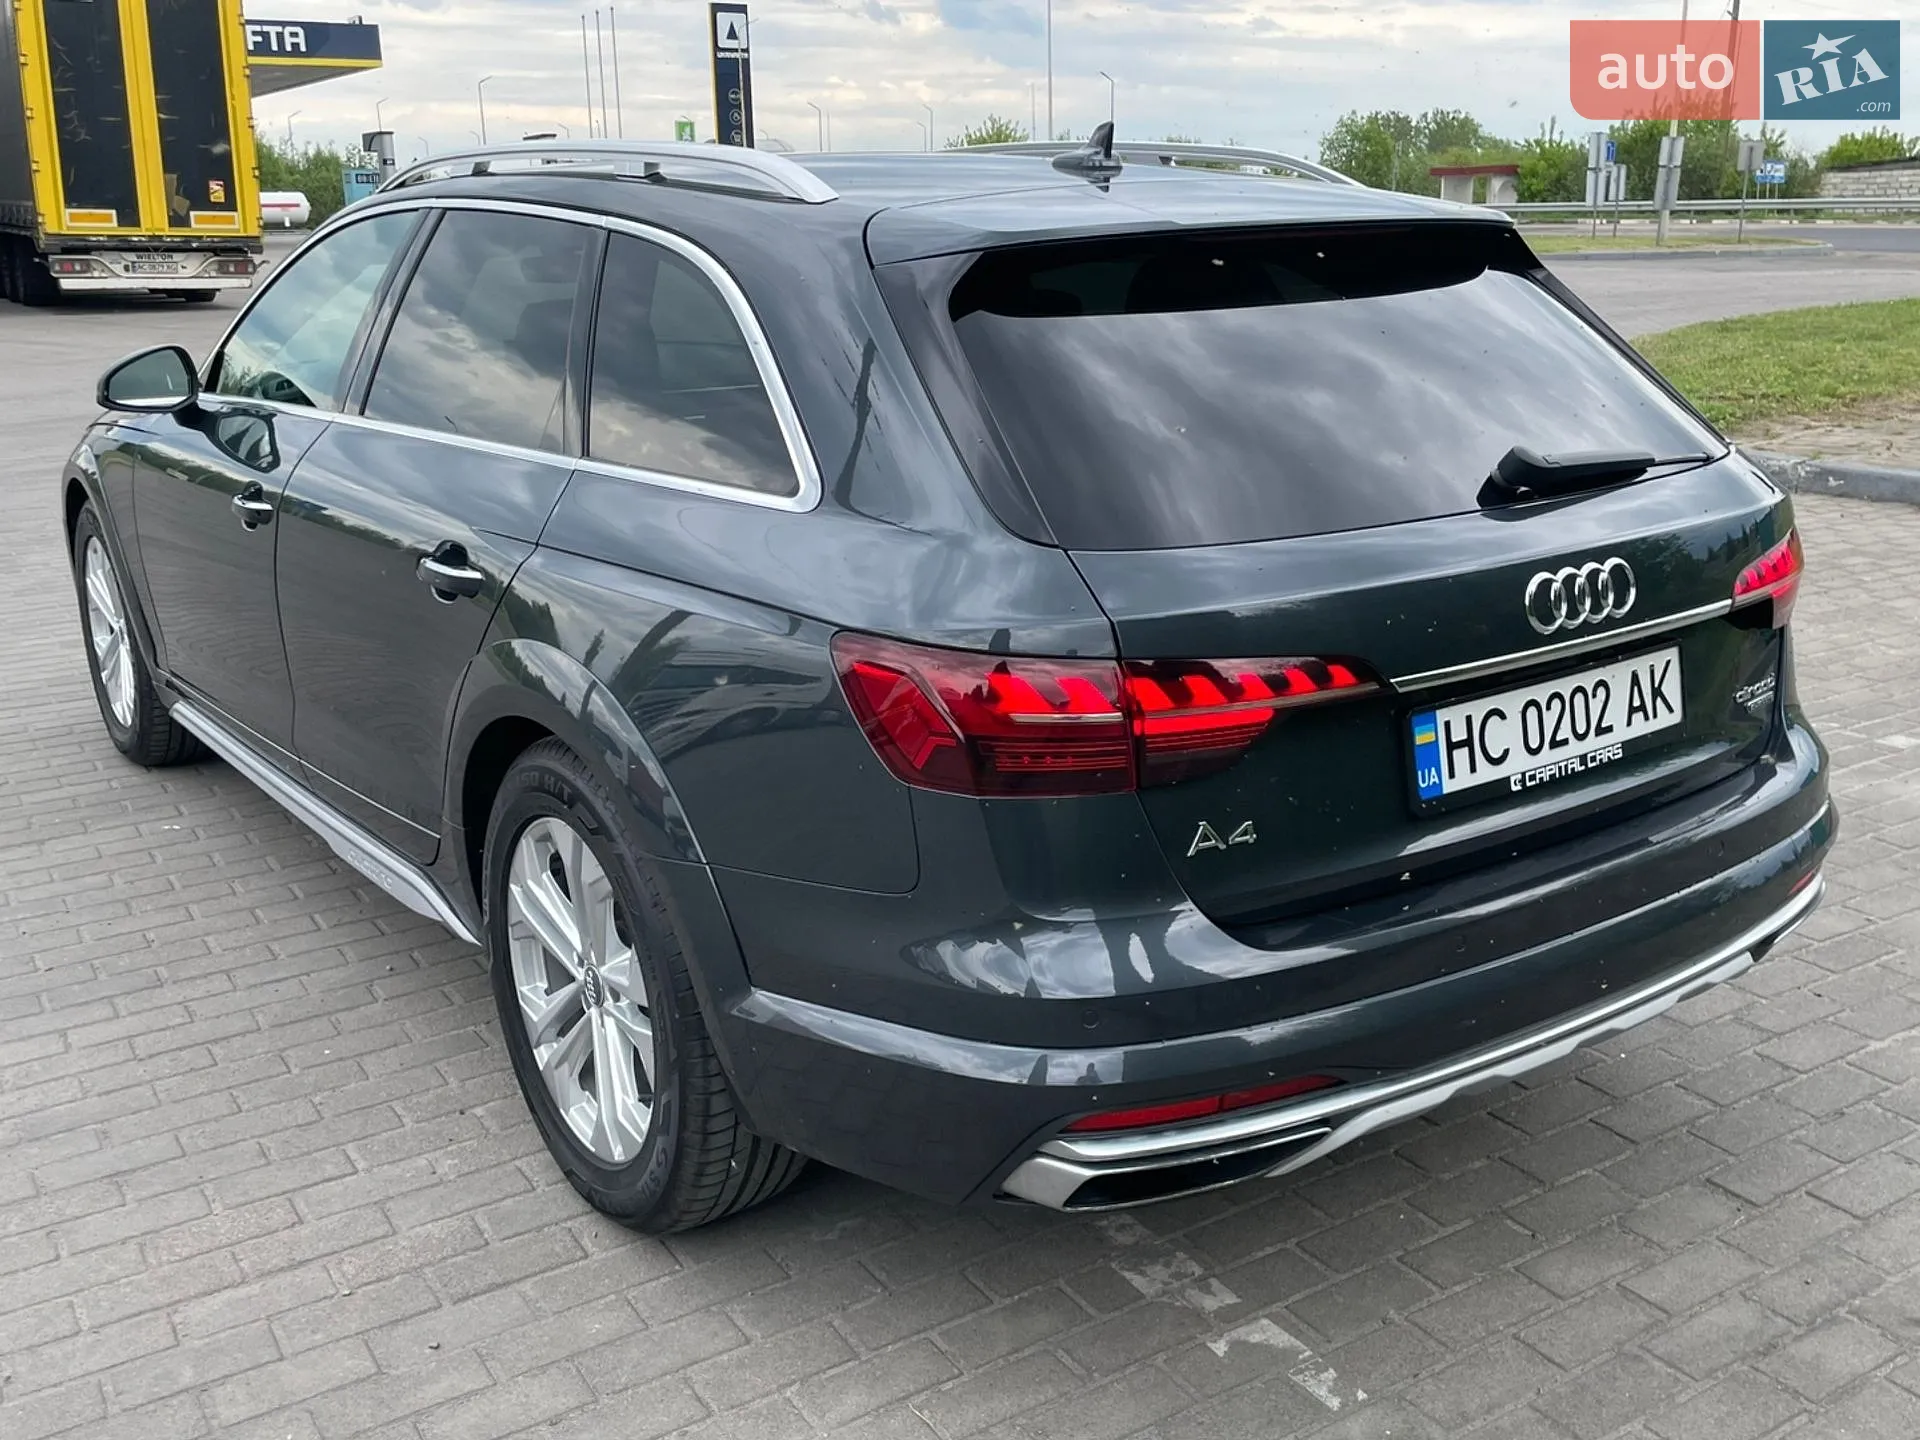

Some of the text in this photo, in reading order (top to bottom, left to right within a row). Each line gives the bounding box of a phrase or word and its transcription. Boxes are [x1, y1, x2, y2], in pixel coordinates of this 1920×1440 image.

[1443, 658, 1675, 780] HC 0202 AK
[1417, 766, 1440, 788] UA
[1525, 743, 1623, 787] CAPITAL CARS
[1187, 821, 1257, 857] A4
